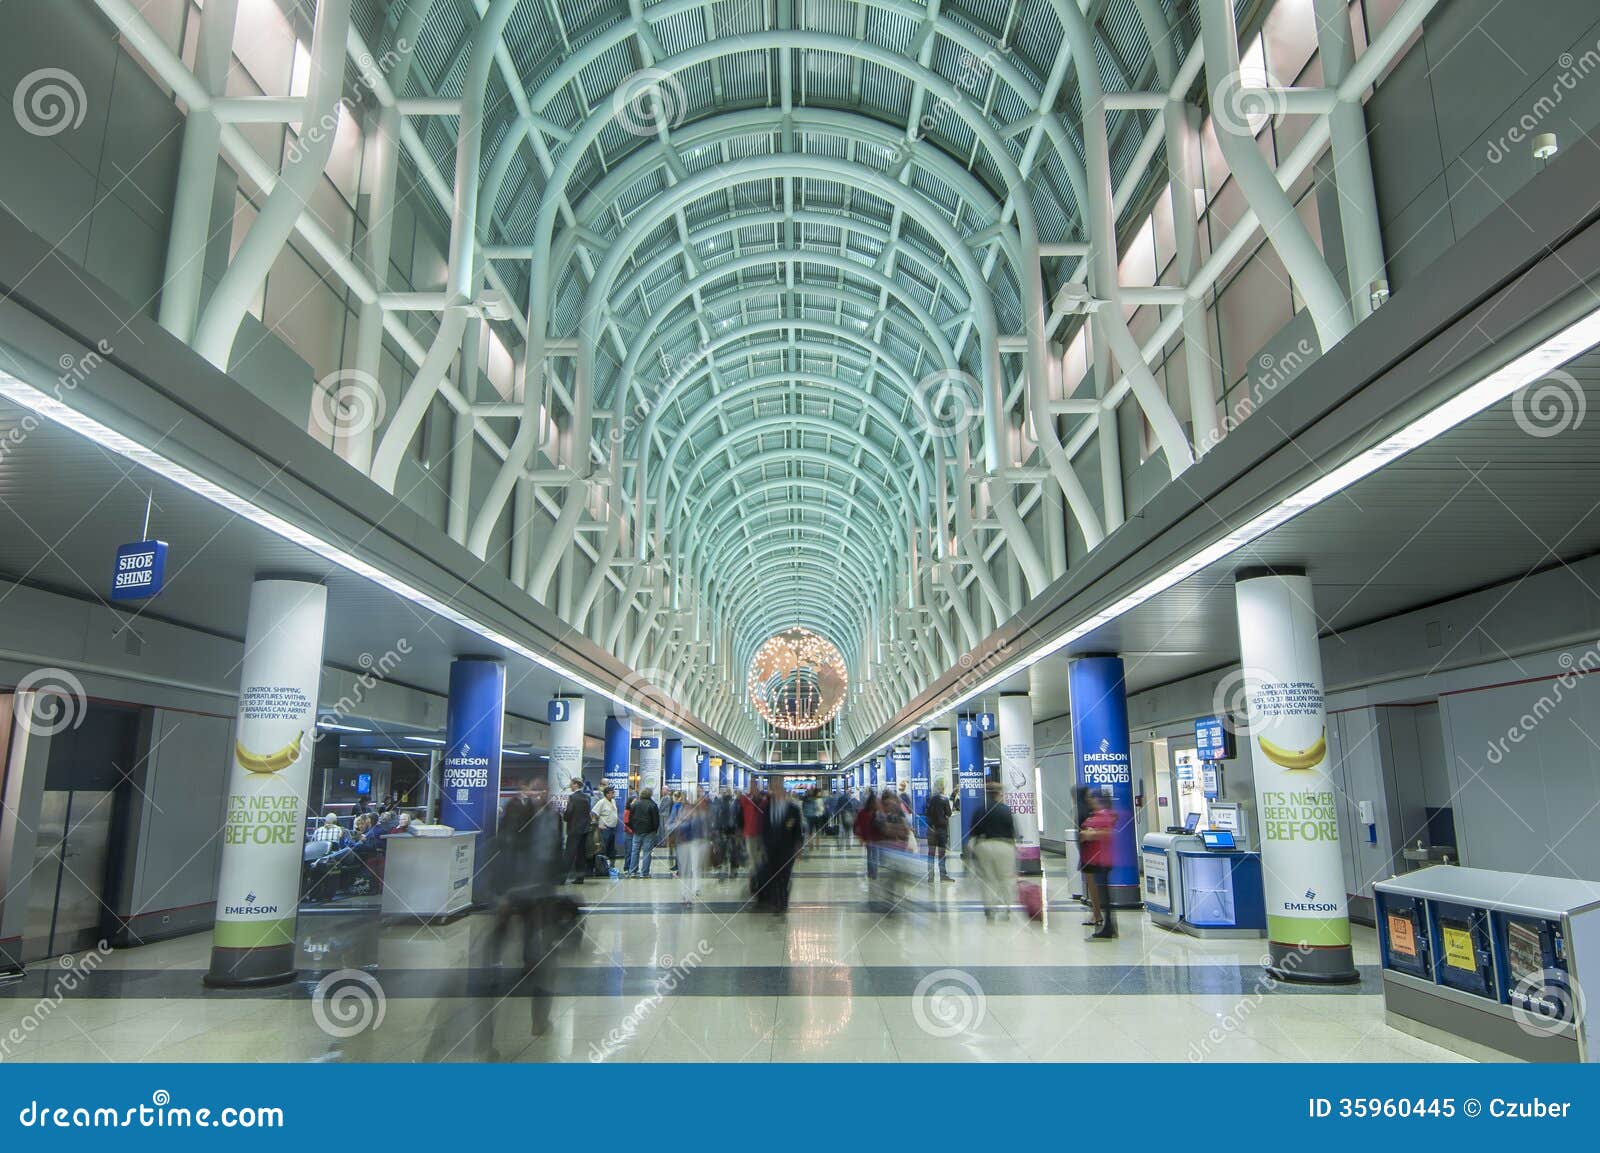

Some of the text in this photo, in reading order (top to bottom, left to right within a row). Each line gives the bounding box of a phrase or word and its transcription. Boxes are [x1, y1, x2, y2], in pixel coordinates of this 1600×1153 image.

[120, 555, 153, 570] SHOE
[116, 570, 152, 585] SHINE
[640, 739, 650, 747] K2
[445, 758, 489, 766] EMERSON
[1084, 753, 1128, 761] EMERSON
[444, 769, 488, 778] CONSIDER
[1085, 764, 1129, 774] CONSIDER
[444, 778, 488, 788] IT SOLVED
[1085, 773, 1129, 783] IT SOLVED
[249, 796, 298, 809] NEVER
[1263, 792, 1334, 805] IT'S NEVER
[1009, 805, 1035, 814] EFORE
[1264, 807, 1336, 819] BEEN DONE
[227, 811, 297, 824] BEEN DONE
[225, 825, 297, 844] BEFORE
[1266, 821, 1338, 840] BEFORE
[225, 905, 277, 915] EMERSON
[1284, 902, 1338, 912] EMERSON
